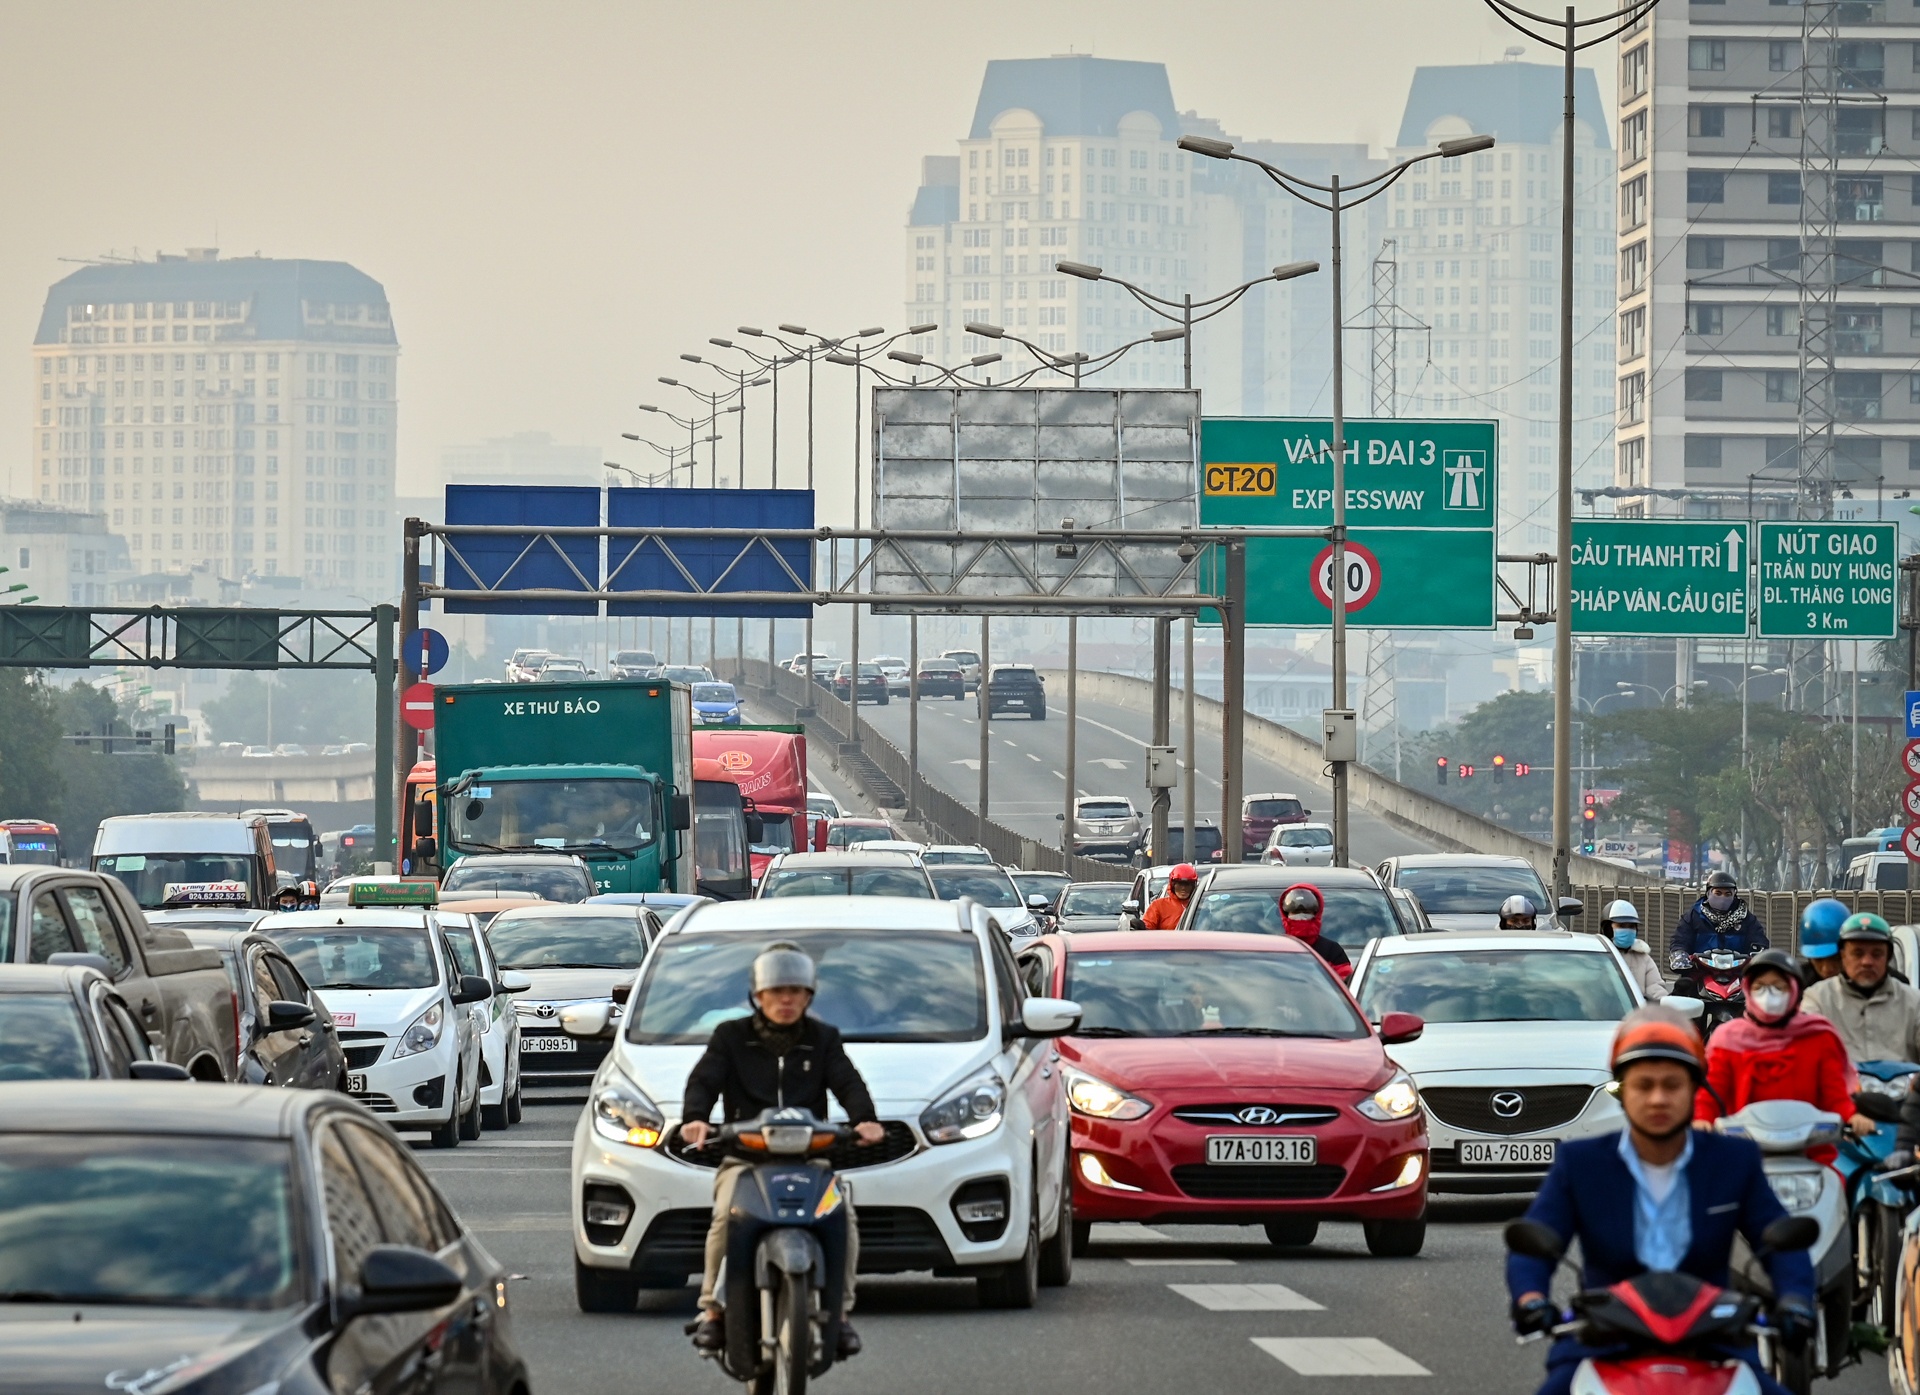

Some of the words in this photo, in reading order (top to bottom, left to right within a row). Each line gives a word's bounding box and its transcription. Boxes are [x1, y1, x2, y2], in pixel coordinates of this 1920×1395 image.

[1283, 434, 1360, 465] VÀNH
[1367, 440, 1415, 465] ĐAI
[1419, 440, 1436, 465] 3
[1207, 467, 1275, 492] CT.20
[1292, 489, 1425, 510] EXPESSWAY
[1570, 537, 1609, 566] CẦU
[1613, 545, 1684, 567] THANH
[1688, 542, 1721, 567] TRÌ
[1778, 528, 1820, 555] NÚT
[1828, 534, 1877, 555] GIAO
[1764, 557, 1805, 579] TRẦN
[1811, 563, 1842, 580] DUY
[1849, 562, 1892, 580] HƯNG
[1711, 588, 1744, 614] GIẼ
[1764, 587, 1788, 604] ĐL.
[1790, 584, 1844, 604] THĂNG
[1852, 587, 1892, 604] LONG
[1806, 612, 1817, 628] 3
[1823, 612, 1848, 629] Km
[503, 702, 525, 716] XE
[528, 700, 560, 715] THƯ
[564, 697, 601, 714] BÁO
[1459, 765, 1473, 778] 31
[1515, 763, 1529, 777] 31
[1605, 843, 1626, 852] BIDV
[1214, 1140, 1311, 1161] 17A-013.16
[1463, 1144, 1553, 1162] 30A-760.89
